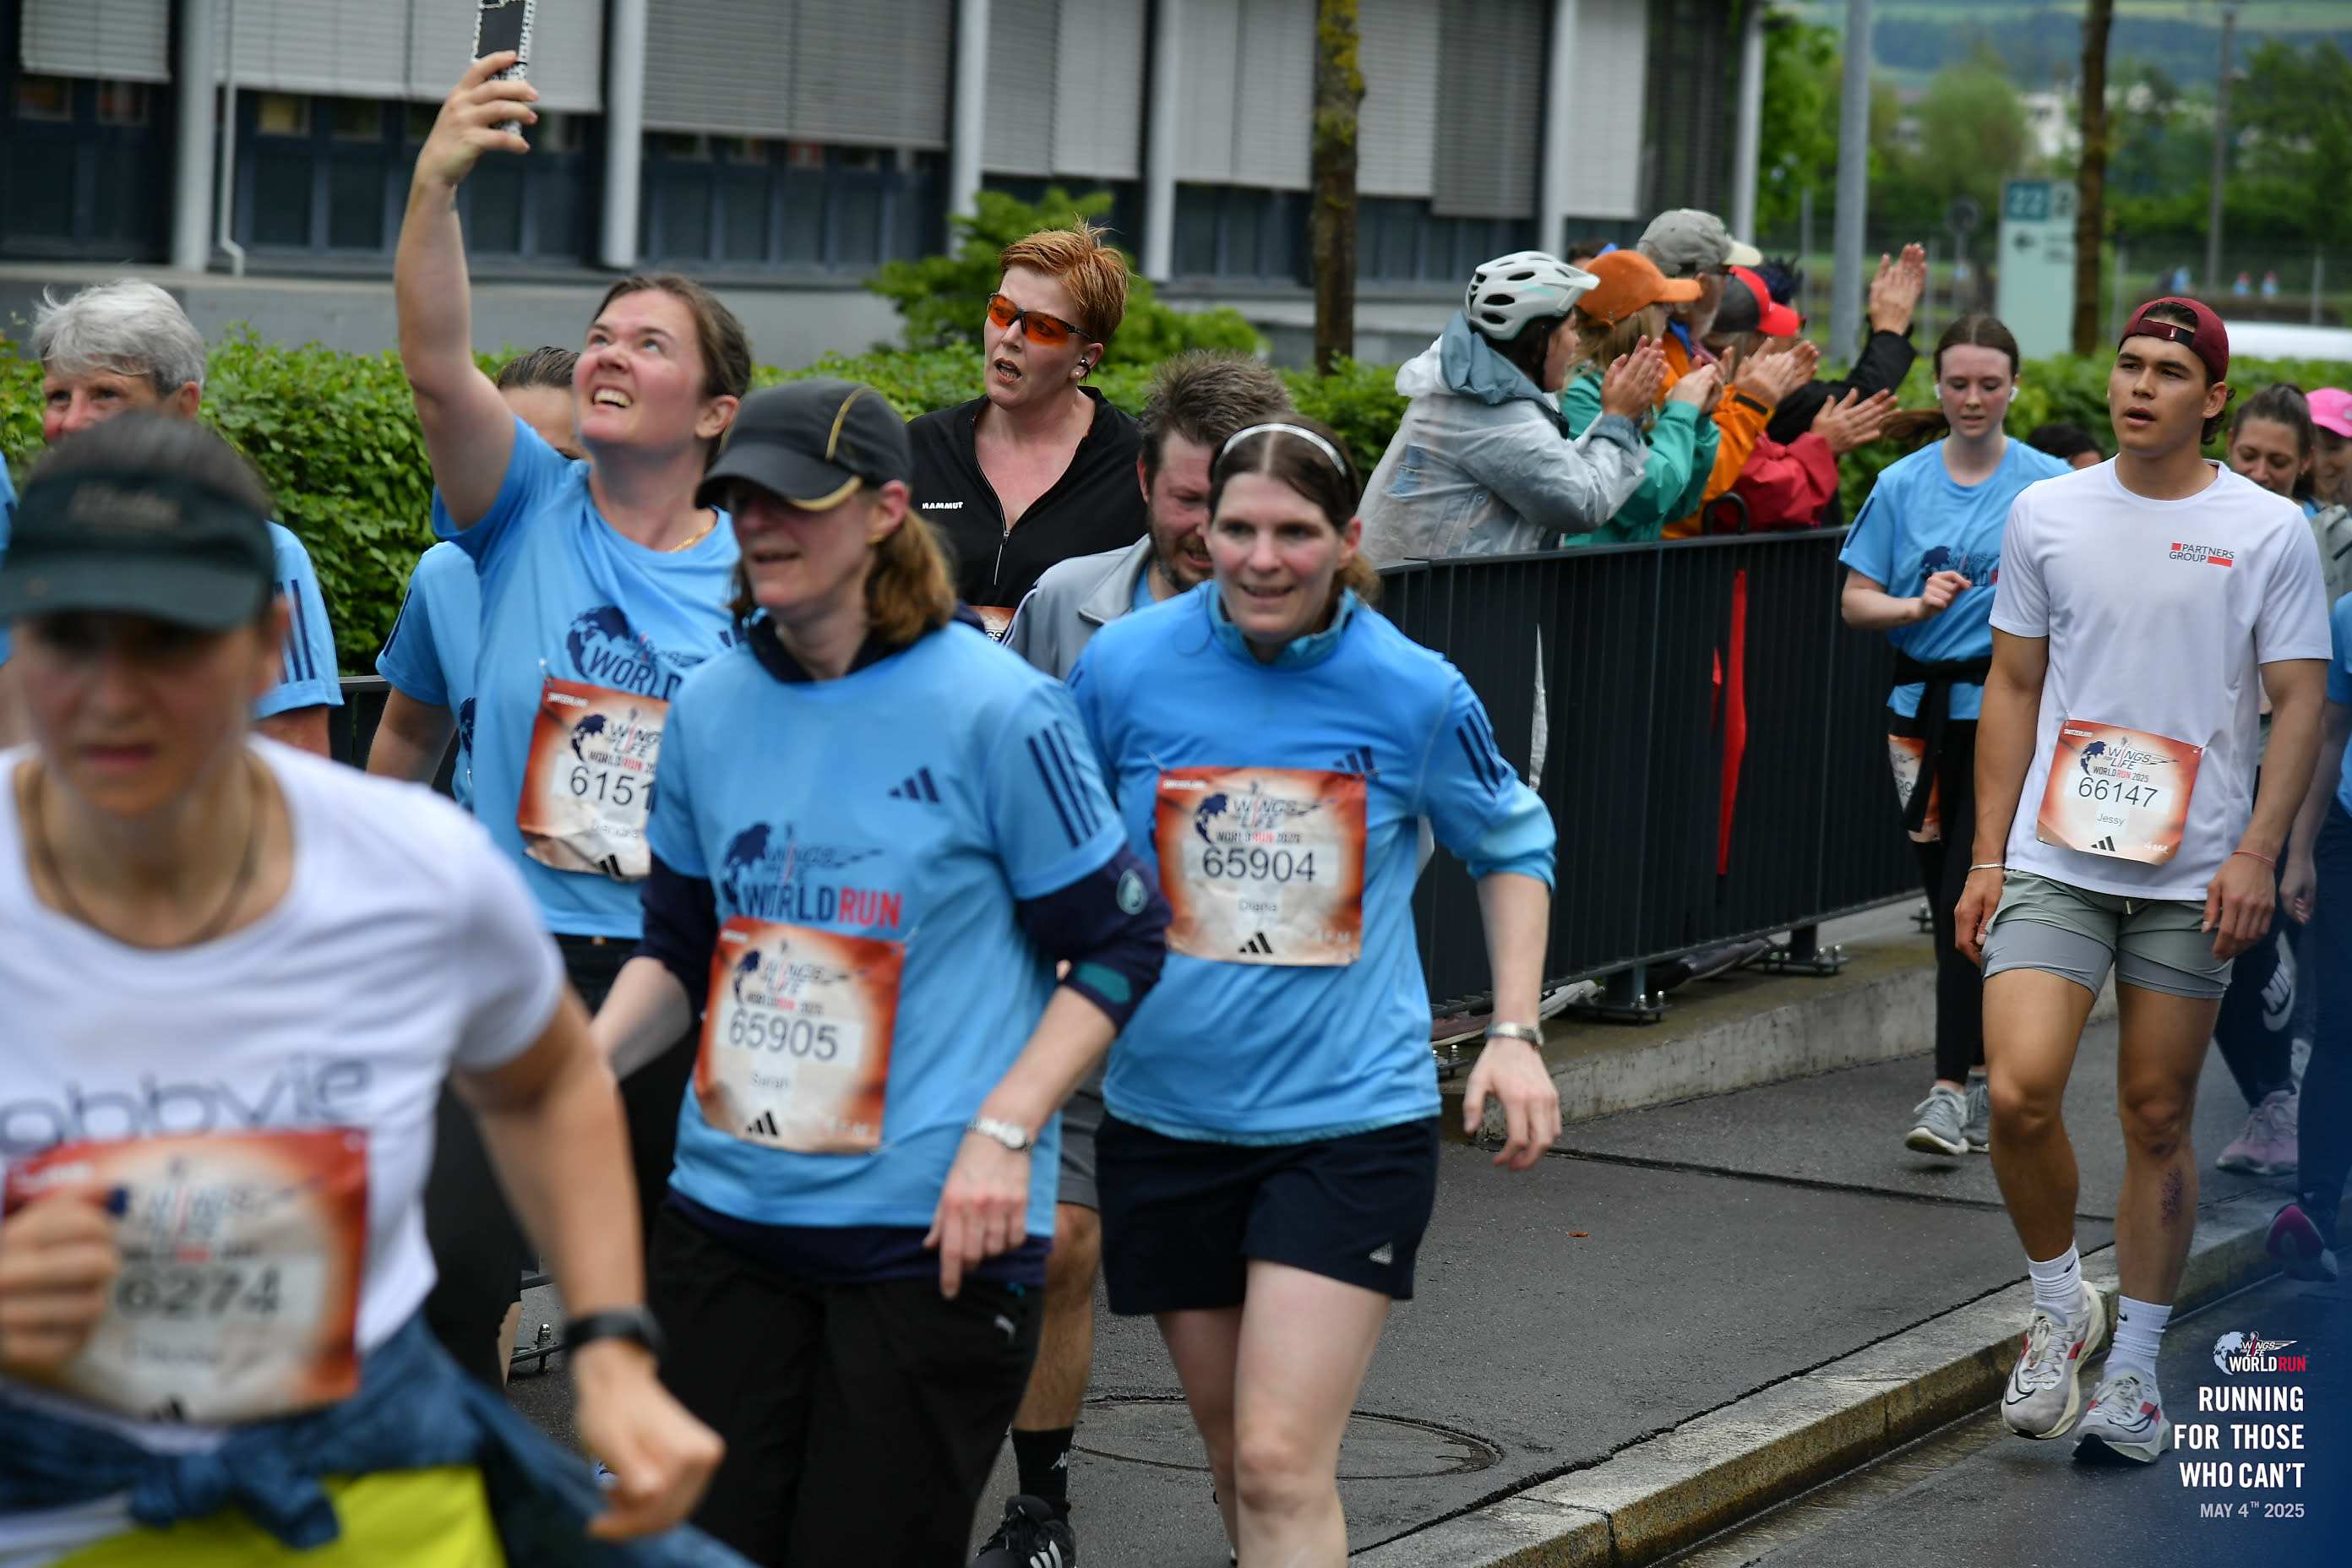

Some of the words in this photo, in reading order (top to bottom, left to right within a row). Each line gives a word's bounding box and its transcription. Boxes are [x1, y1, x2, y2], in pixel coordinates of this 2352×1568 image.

[922, 501, 963, 509] MAMMUT
[2169, 551, 2207, 562] GROUP
[2182, 543, 2235, 559] PARTNERS
[2108, 746, 2152, 763] WINGS
[2110, 757, 2137, 770] LIFE
[2132, 772, 2149, 782] 2025
[2078, 776, 2159, 807] 66147
[2097, 813, 2126, 827] Jessy
[1202, 847, 1316, 883] 65904
[729, 1006, 839, 1061] 65905
[115, 1266, 282, 1320] 6274
